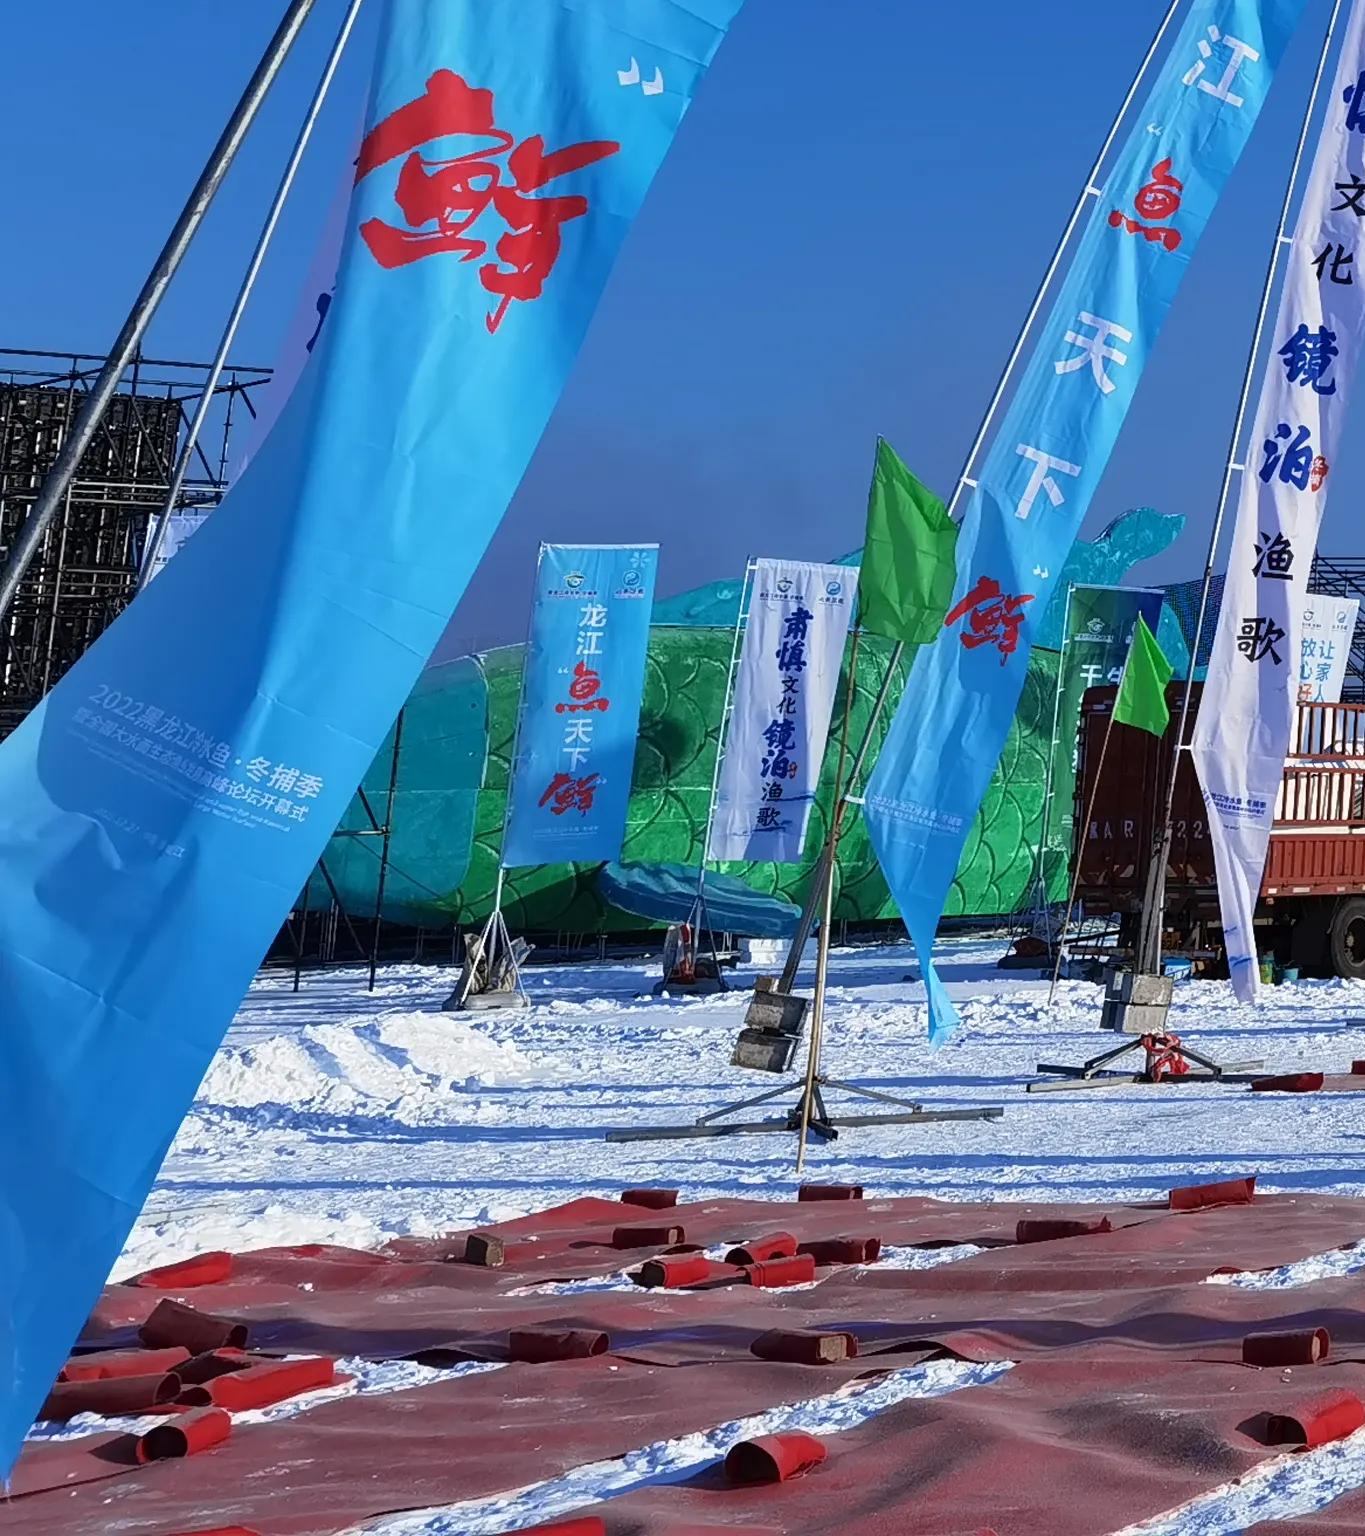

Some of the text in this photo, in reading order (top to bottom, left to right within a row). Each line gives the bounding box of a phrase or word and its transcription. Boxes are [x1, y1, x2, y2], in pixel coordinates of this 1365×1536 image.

[755, 606, 814, 827] 肃慎文化镜泊渔歌
